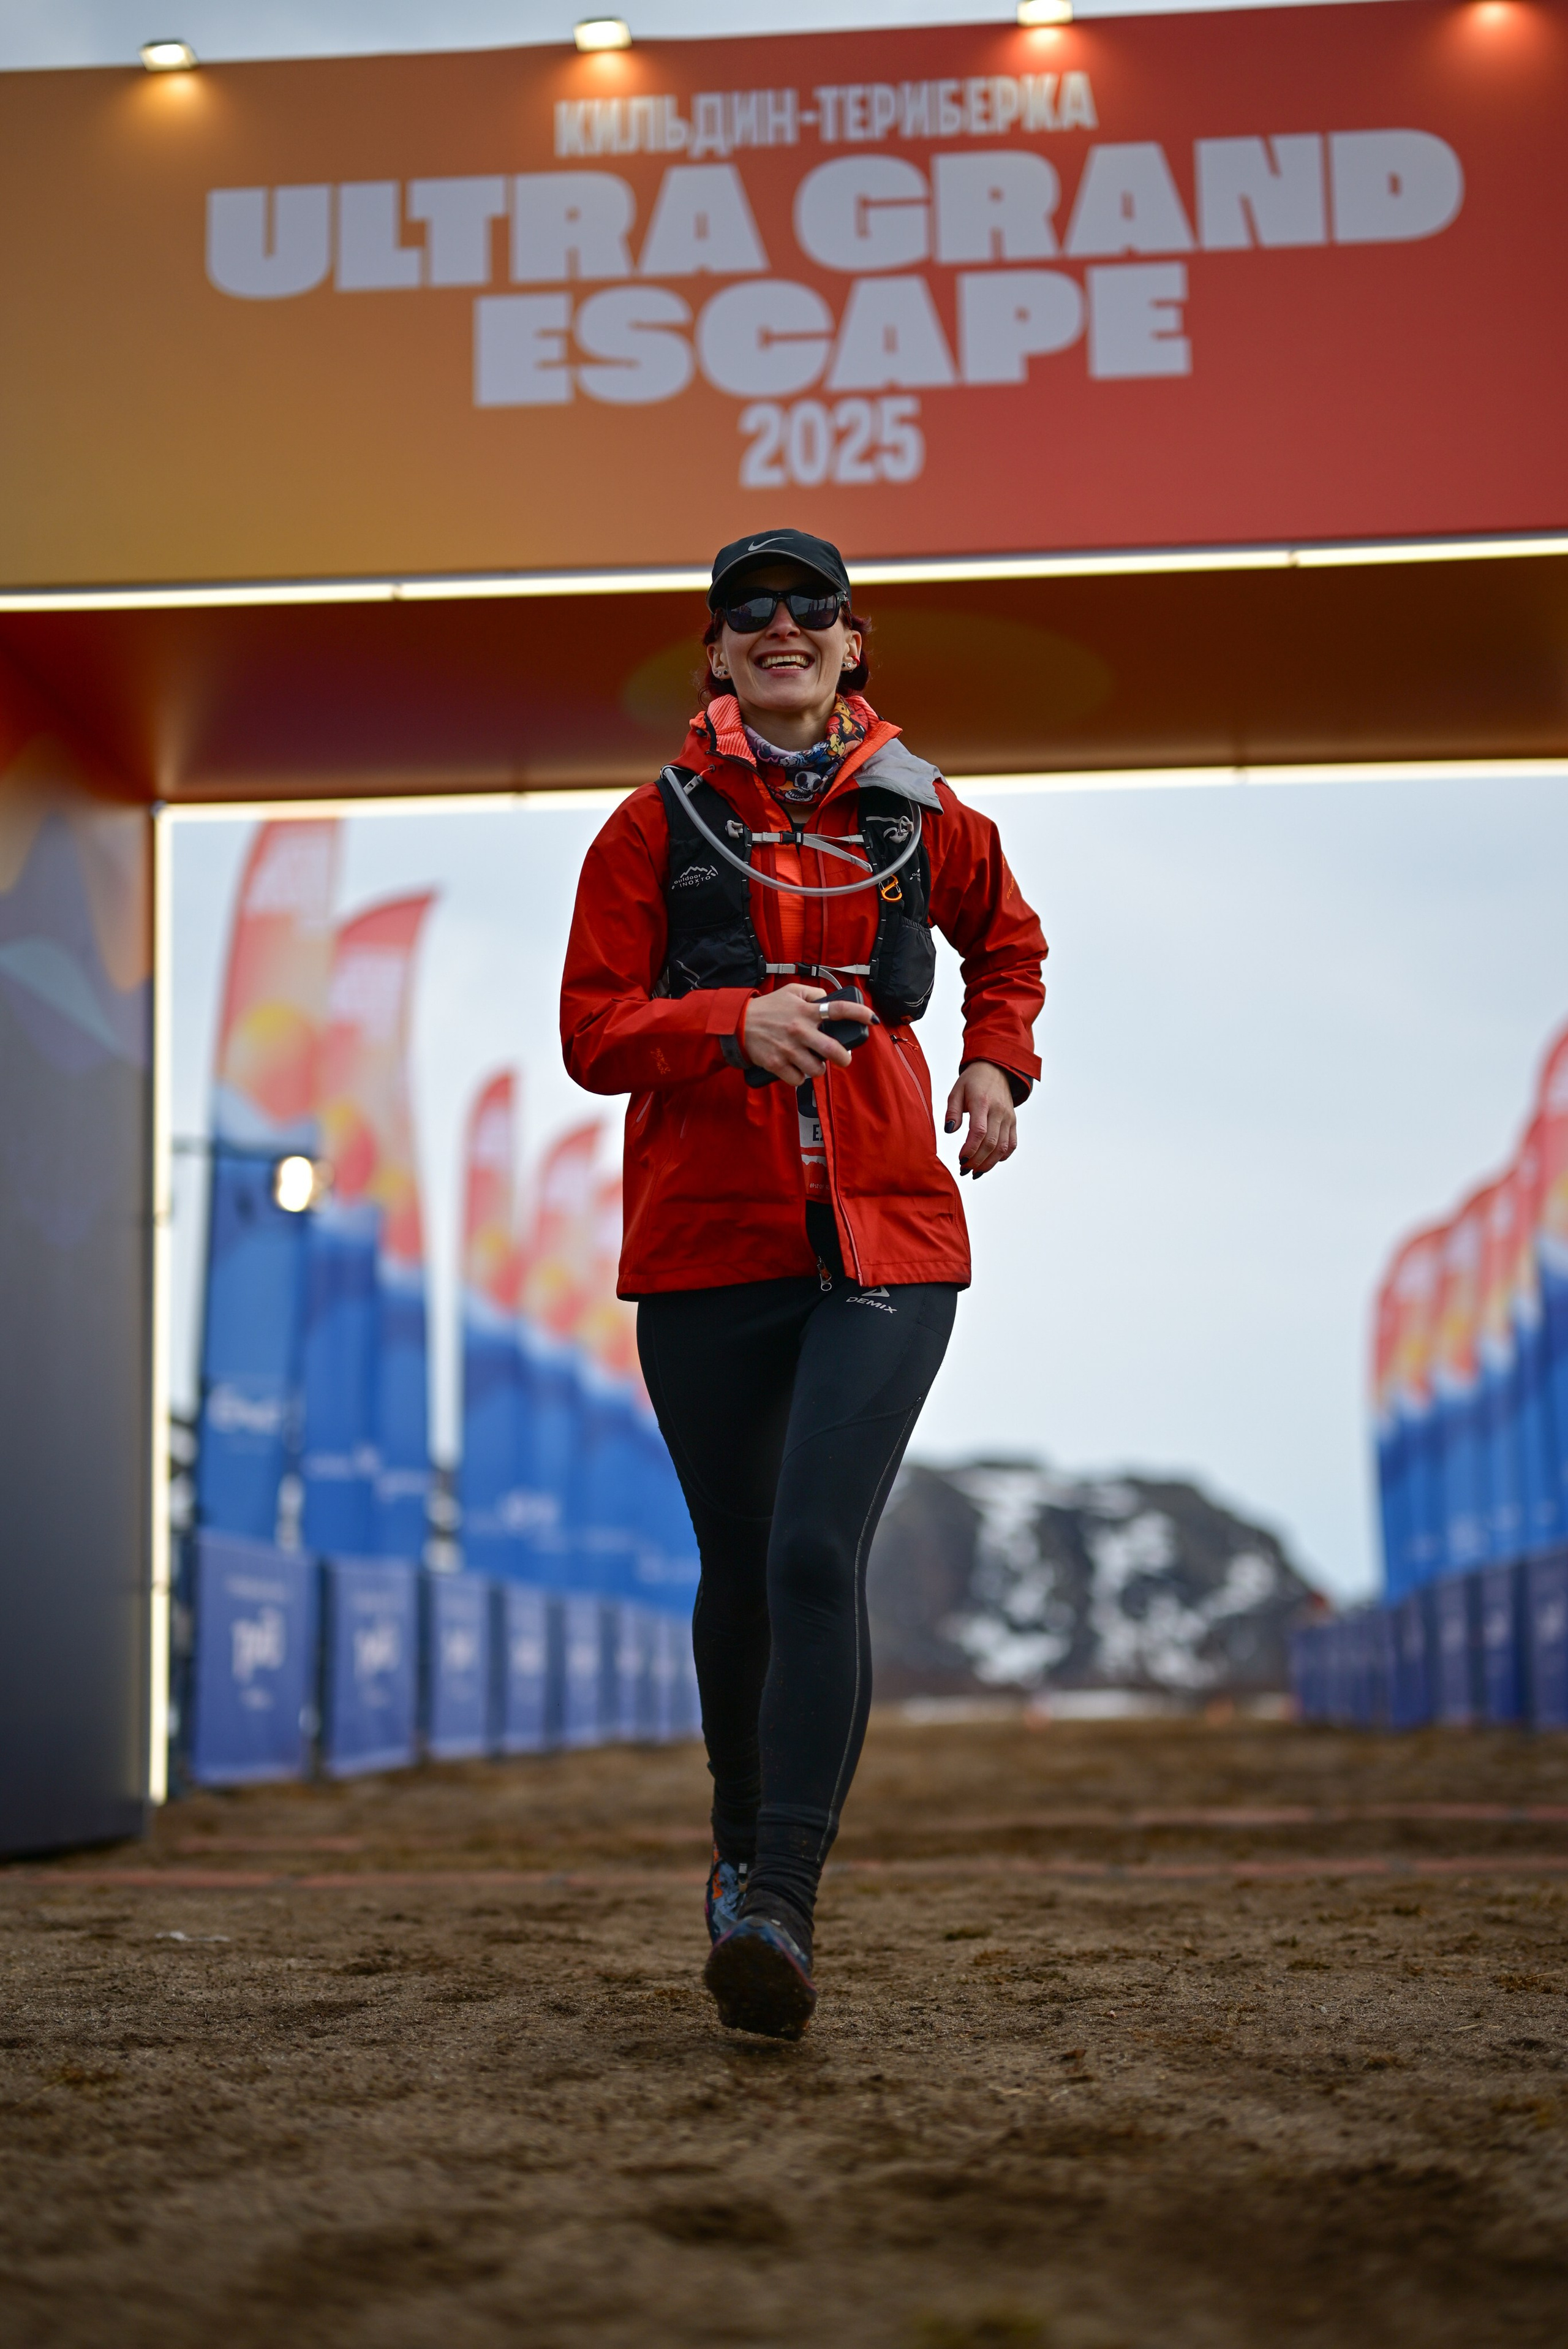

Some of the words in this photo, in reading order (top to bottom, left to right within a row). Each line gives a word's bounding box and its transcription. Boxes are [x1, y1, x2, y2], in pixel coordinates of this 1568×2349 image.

[554, 70, 1098, 161] КИЛЬДИН-ТЕРИБЕРКА
[205, 162, 770, 301] ULTRA
[792, 128, 1464, 273] GRAND
[472, 260, 1192, 409] ESCAPE
[738, 395, 925, 489] 2025
[846, 1296, 898, 1314] DEMIX
